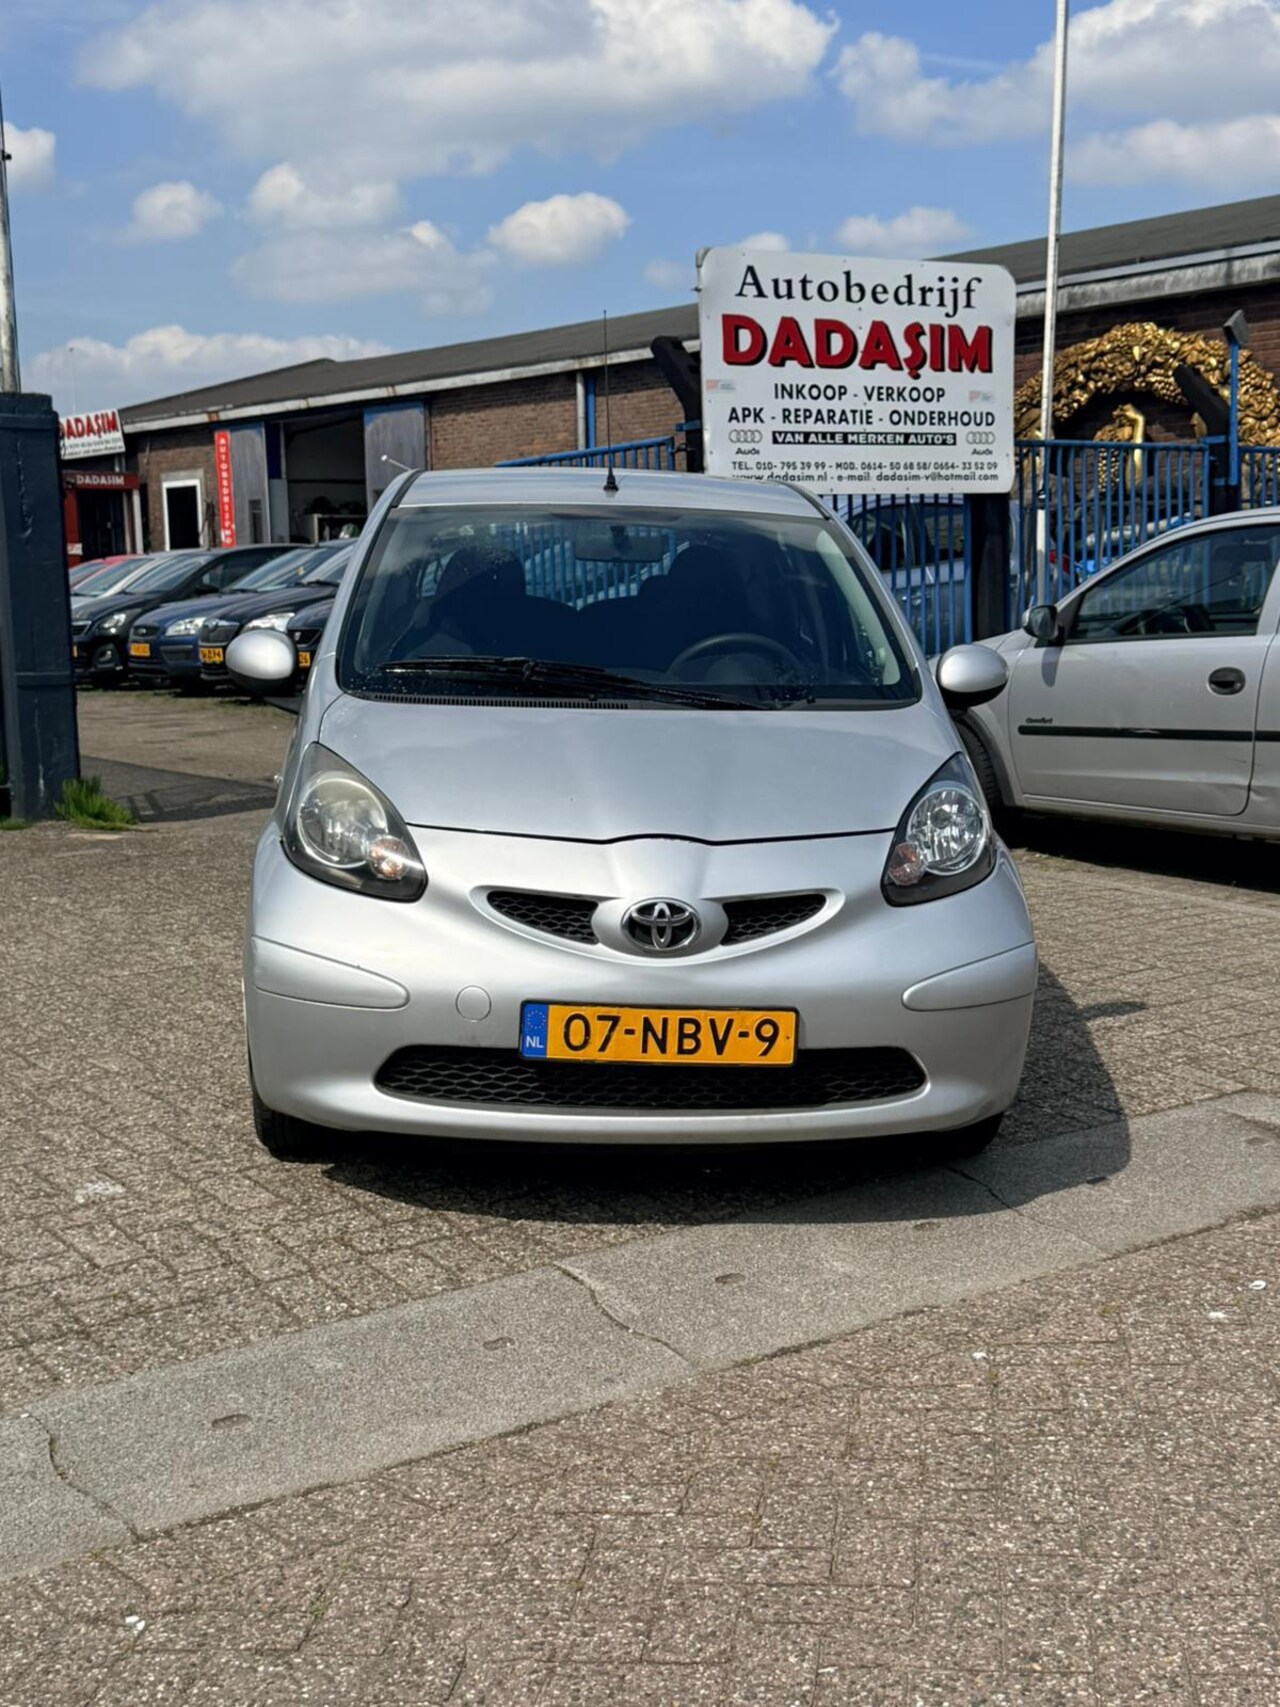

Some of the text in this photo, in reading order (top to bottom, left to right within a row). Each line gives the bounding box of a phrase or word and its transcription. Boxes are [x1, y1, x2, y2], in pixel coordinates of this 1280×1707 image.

[735, 264, 983, 318] Autobedrijf
[721, 313, 994, 381] DADAŞIM
[774, 383, 848, 401] INKOOP
[864, 385, 946, 403] VERKOOP
[728, 406, 765, 424] APK
[782, 408, 873, 425] REPARATIE
[889, 409, 996, 427] ONDERHOUD
[774, 432, 955, 444] VAN ALLE MERKEN AUTO'S
[732, 461, 753, 470] TEL.
[755, 461, 777, 470] 010-
[780, 461, 798, 470] 795
[800, 461, 812, 470] 39
[814, 461, 826, 470] 99
[835, 462, 858, 470] MOB.
[860, 461, 887, 470] 0614-
[889, 461, 901, 470] 50
[962, 461, 972, 470] 33
[974, 461, 985, 470] 52
[986, 461, 998, 470] 09
[732, 471, 827, 481] wwdadasim.nl
[526, 1013, 780, 1057] NL 07-NBV-9
